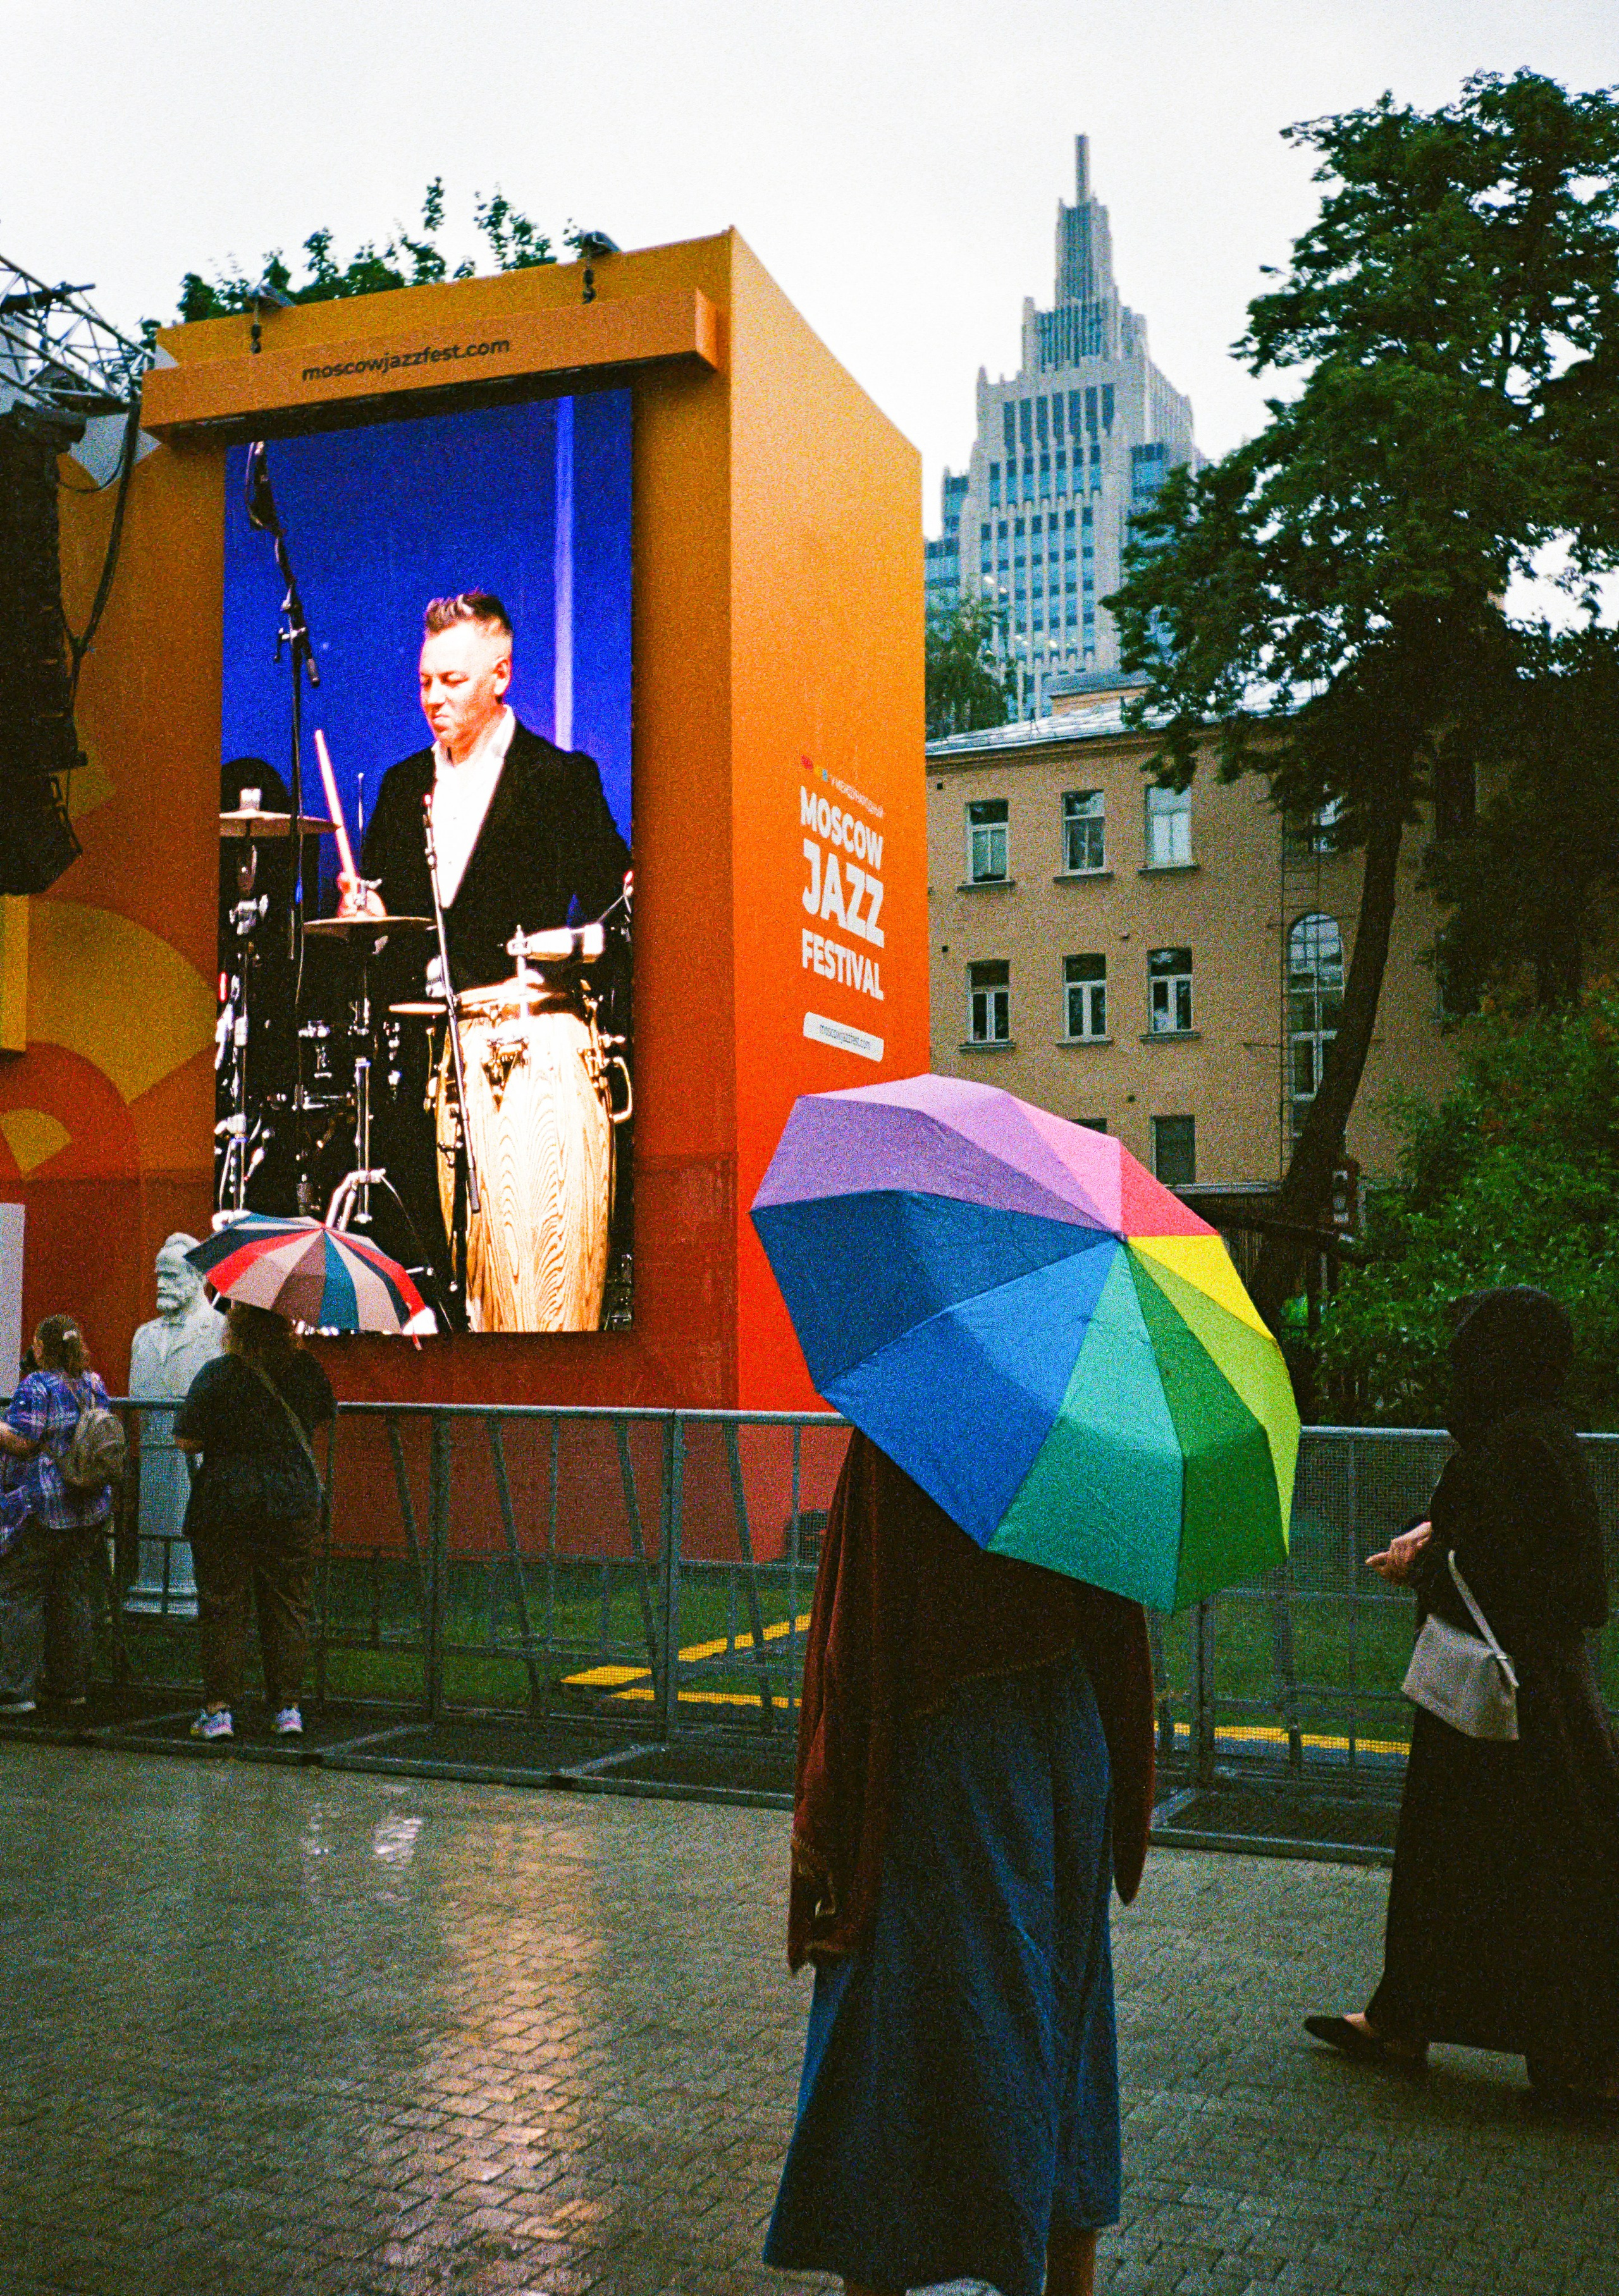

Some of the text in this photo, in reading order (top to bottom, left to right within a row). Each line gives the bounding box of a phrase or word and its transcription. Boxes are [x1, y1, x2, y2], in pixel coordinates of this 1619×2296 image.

[302, 340, 510, 381] moscowjazzfest.com
[800, 785, 883, 871] MOSCOW
[802, 838, 885, 948] JAZZ
[802, 928, 884, 1001] FESTIVAL
